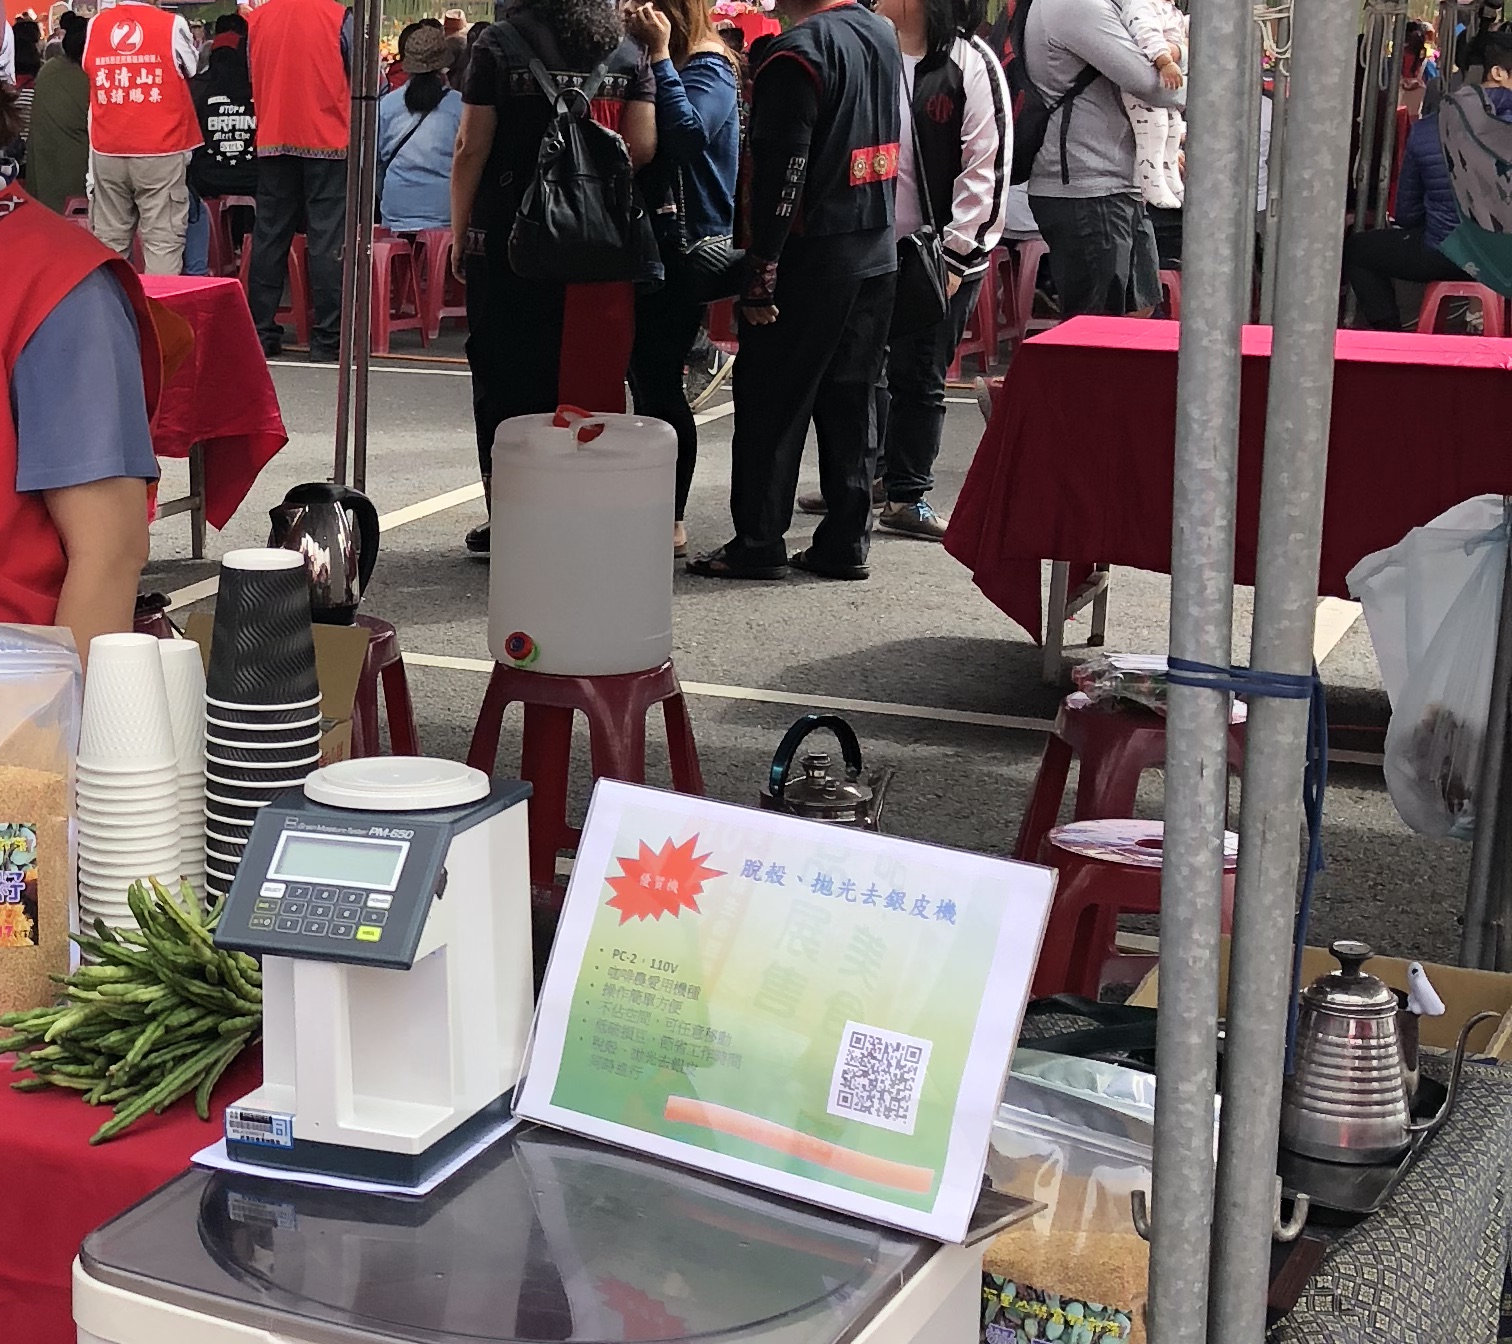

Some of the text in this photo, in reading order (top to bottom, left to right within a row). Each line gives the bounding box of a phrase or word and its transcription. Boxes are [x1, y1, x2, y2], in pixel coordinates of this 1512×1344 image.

[117, 18, 137, 52] 2
[208, 116, 256, 131] BRAIN
[369, 827, 415, 840] PM-650
[639, 872, 679, 895] 優質機
[740, 858, 958, 926] 脫殼、拋光去銀皮機
[602, 982, 684, 1016] 操作簡單方便
